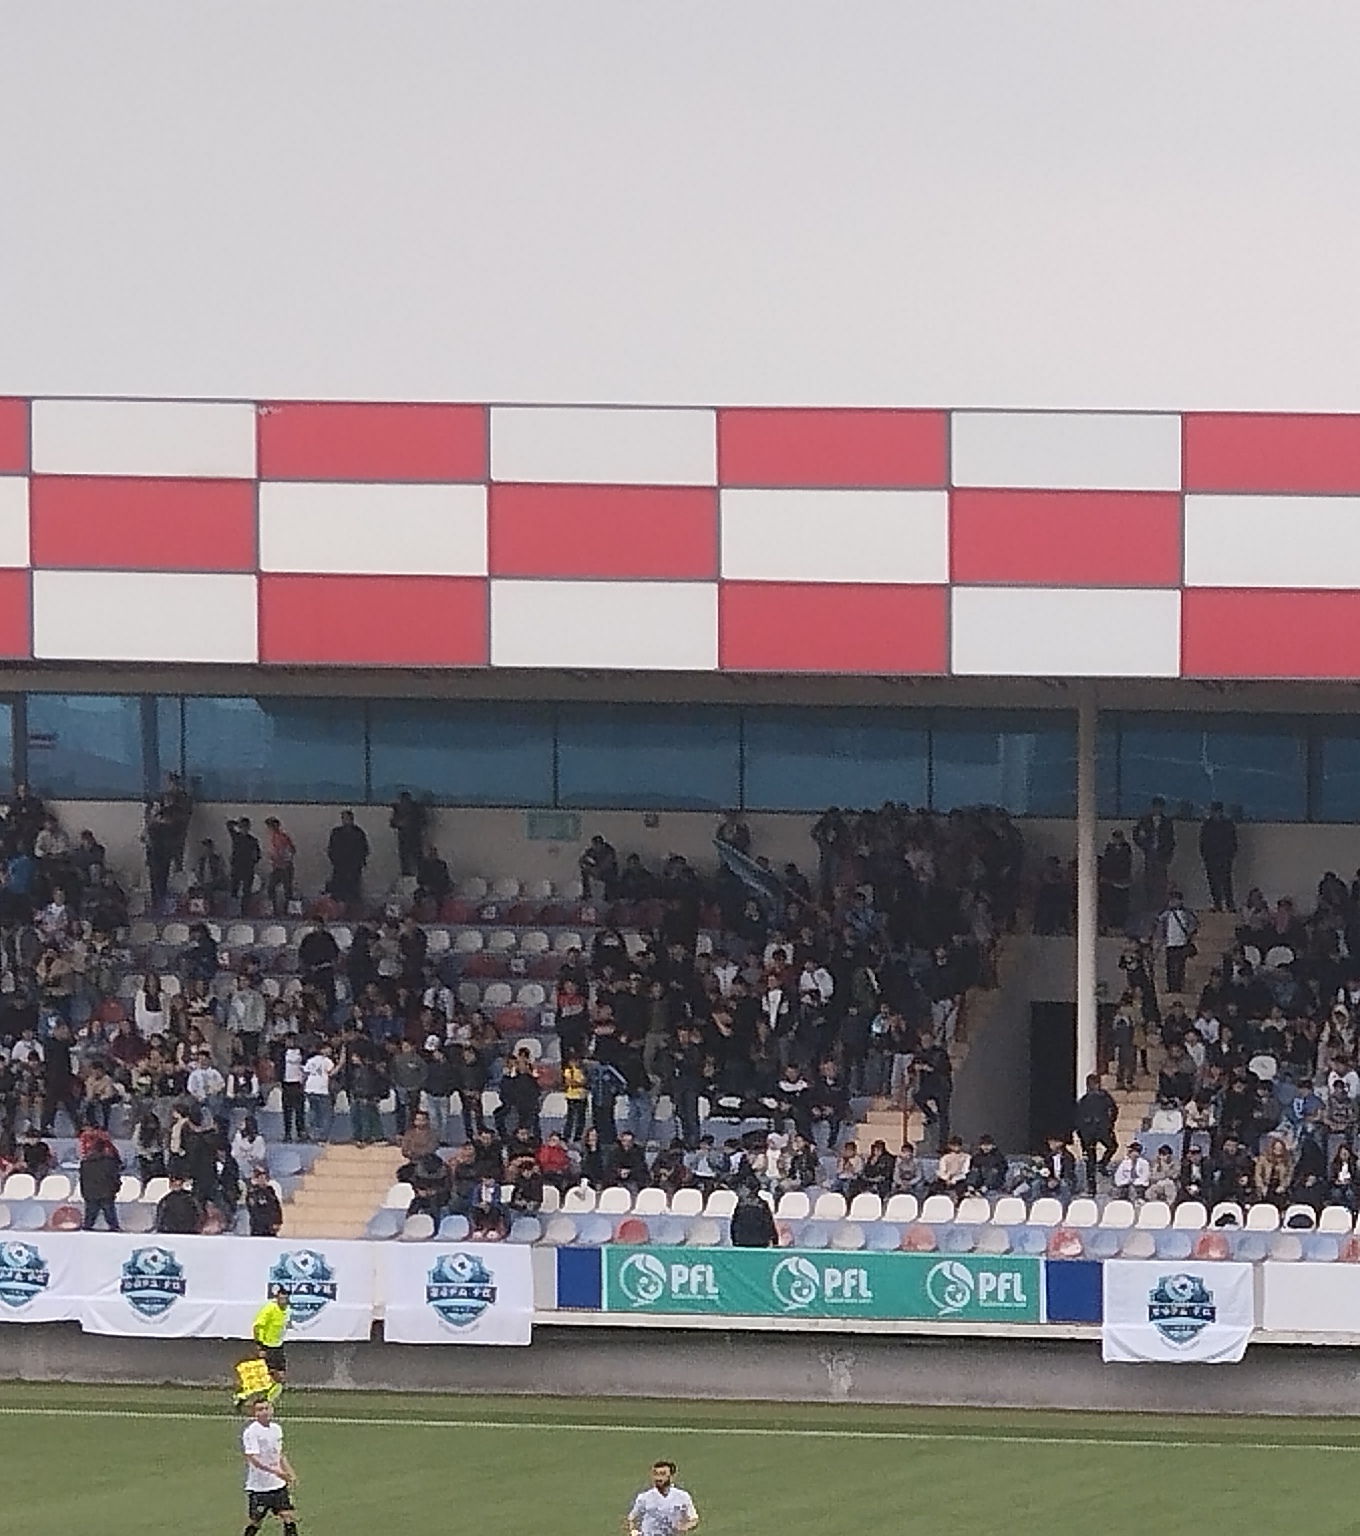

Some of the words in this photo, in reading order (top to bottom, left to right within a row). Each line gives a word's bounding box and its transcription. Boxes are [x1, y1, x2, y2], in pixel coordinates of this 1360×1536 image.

[671, 1264, 719, 1294] PFL
[824, 1268, 873, 1298] PFL
[979, 1272, 1027, 1302] PFL
